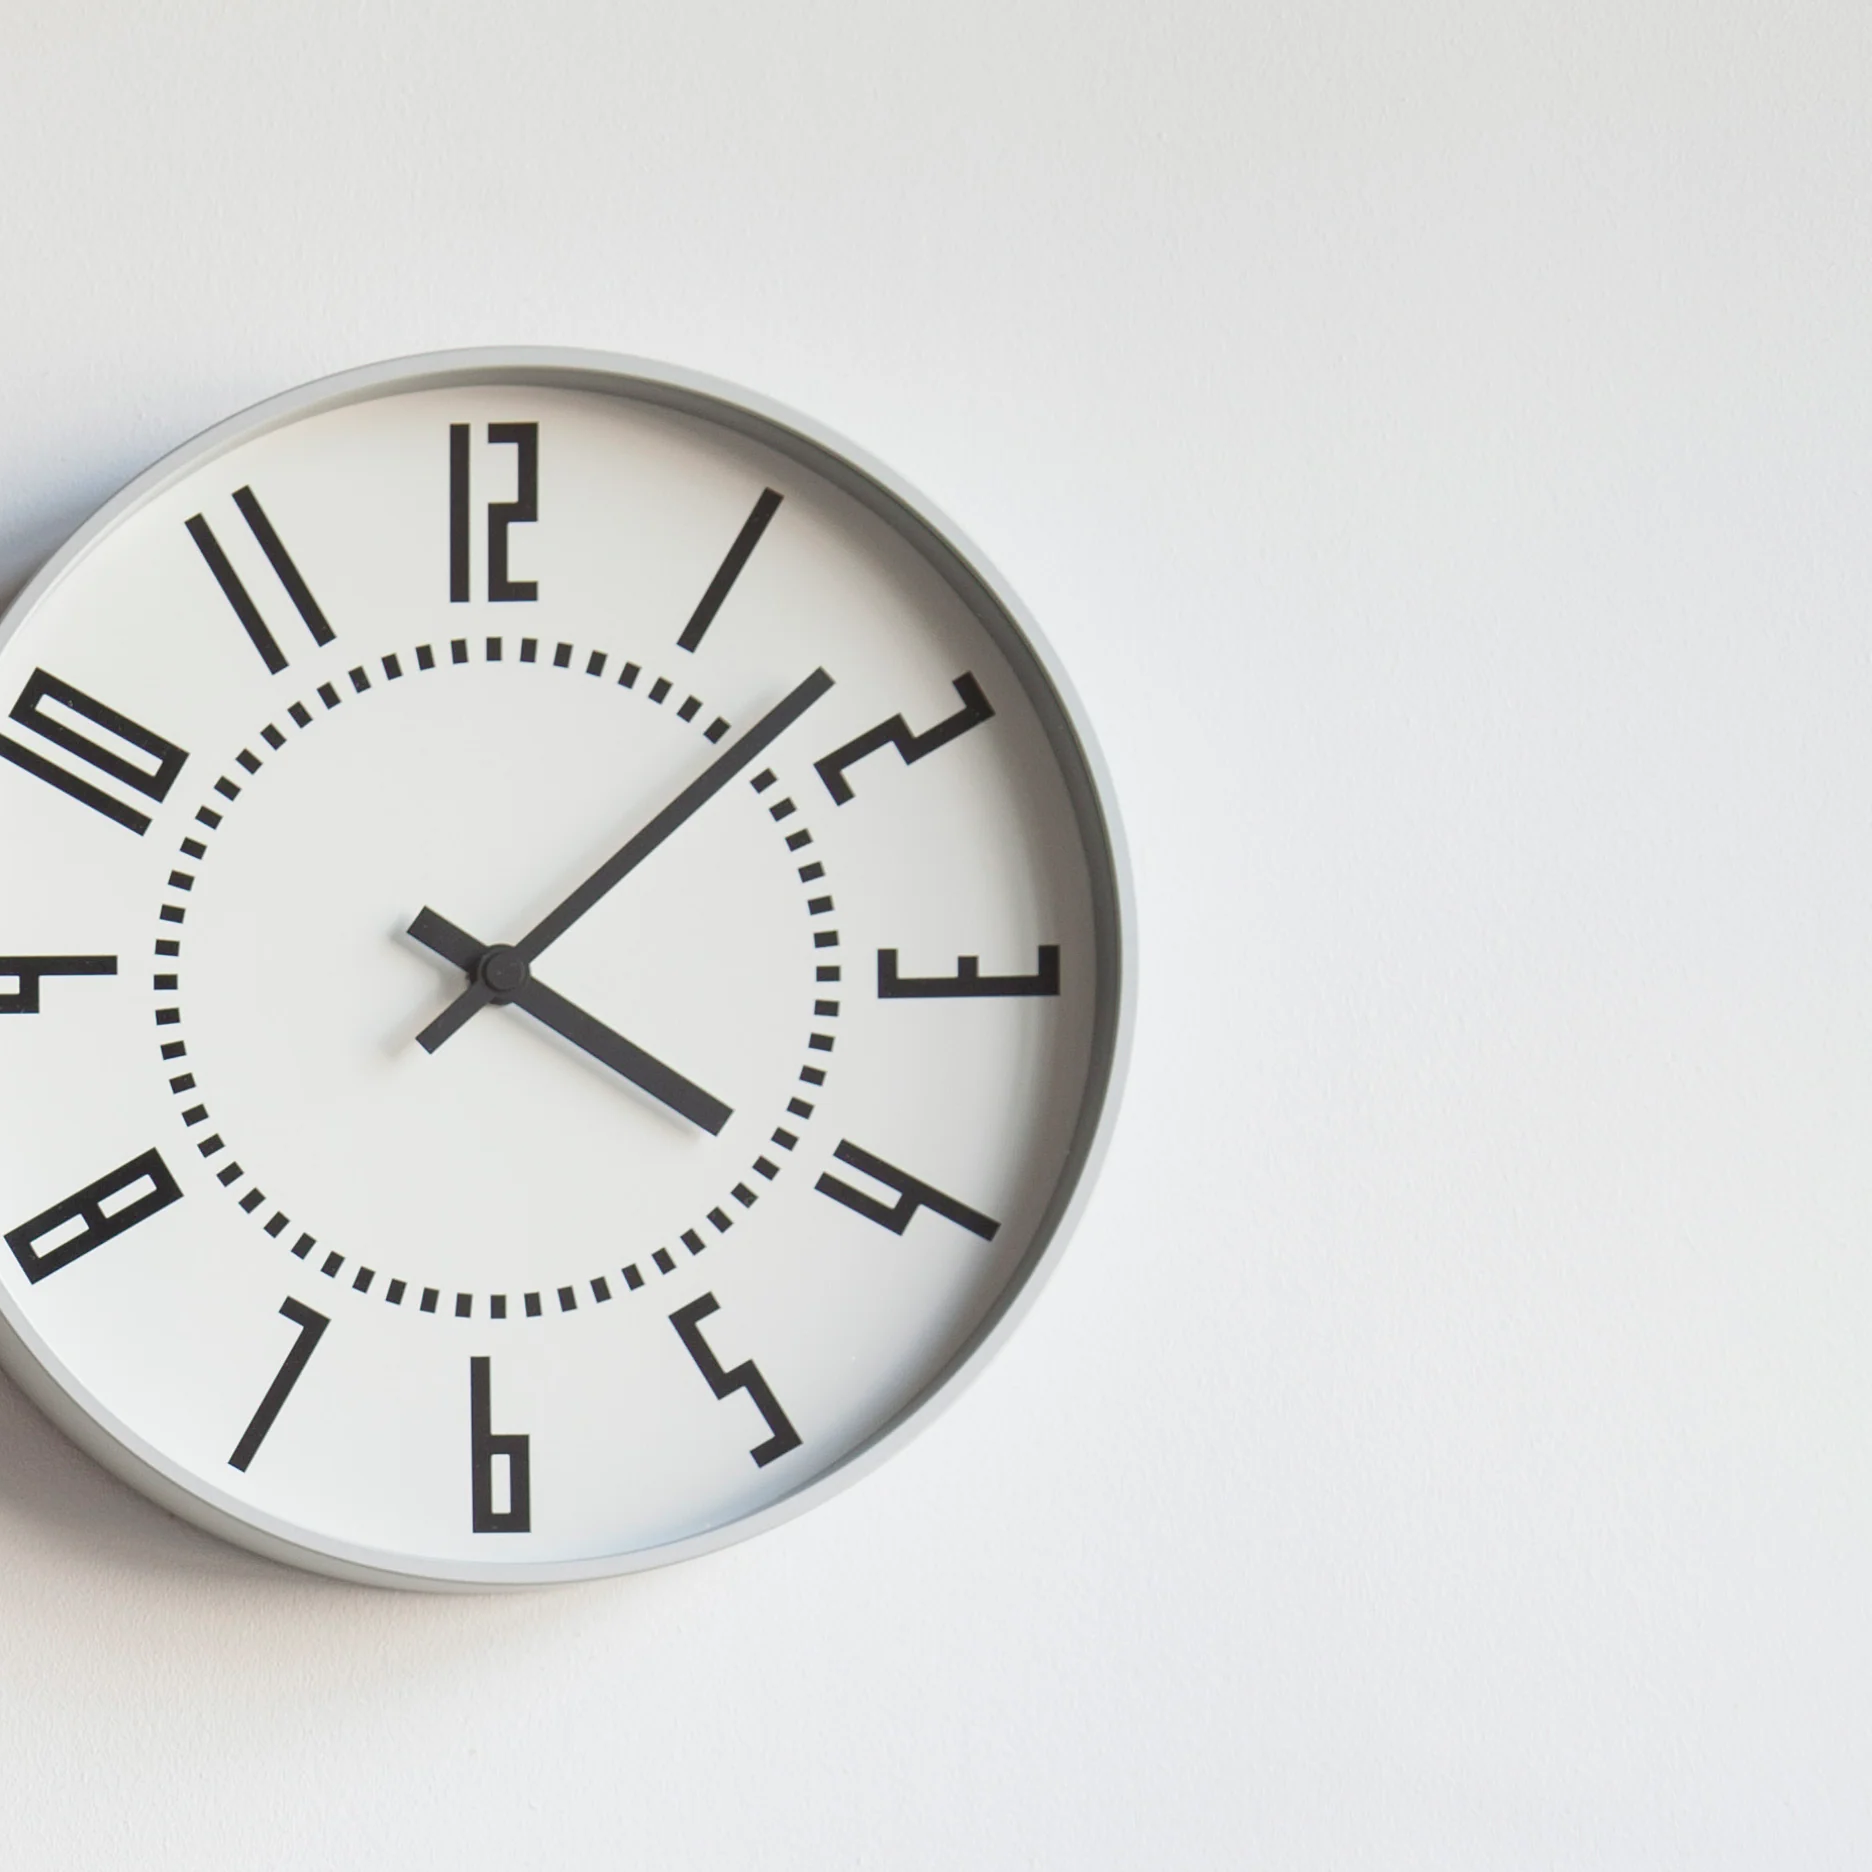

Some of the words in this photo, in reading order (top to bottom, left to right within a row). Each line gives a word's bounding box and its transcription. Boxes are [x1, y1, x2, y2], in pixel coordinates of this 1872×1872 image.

[184, 485, 337, 675] 11
[449, 421, 539, 603] 12
[676, 487, 784, 653] 1
[813, 671, 997, 805] 2
[877, 944, 1061, 999] 3
[3, 1147, 184, 1285] 8
[814, 1140, 1002, 1242] 4
[227, 1296, 332, 1473] 7
[471, 1356, 532, 1534] 6
[668, 1292, 804, 1468] 5
